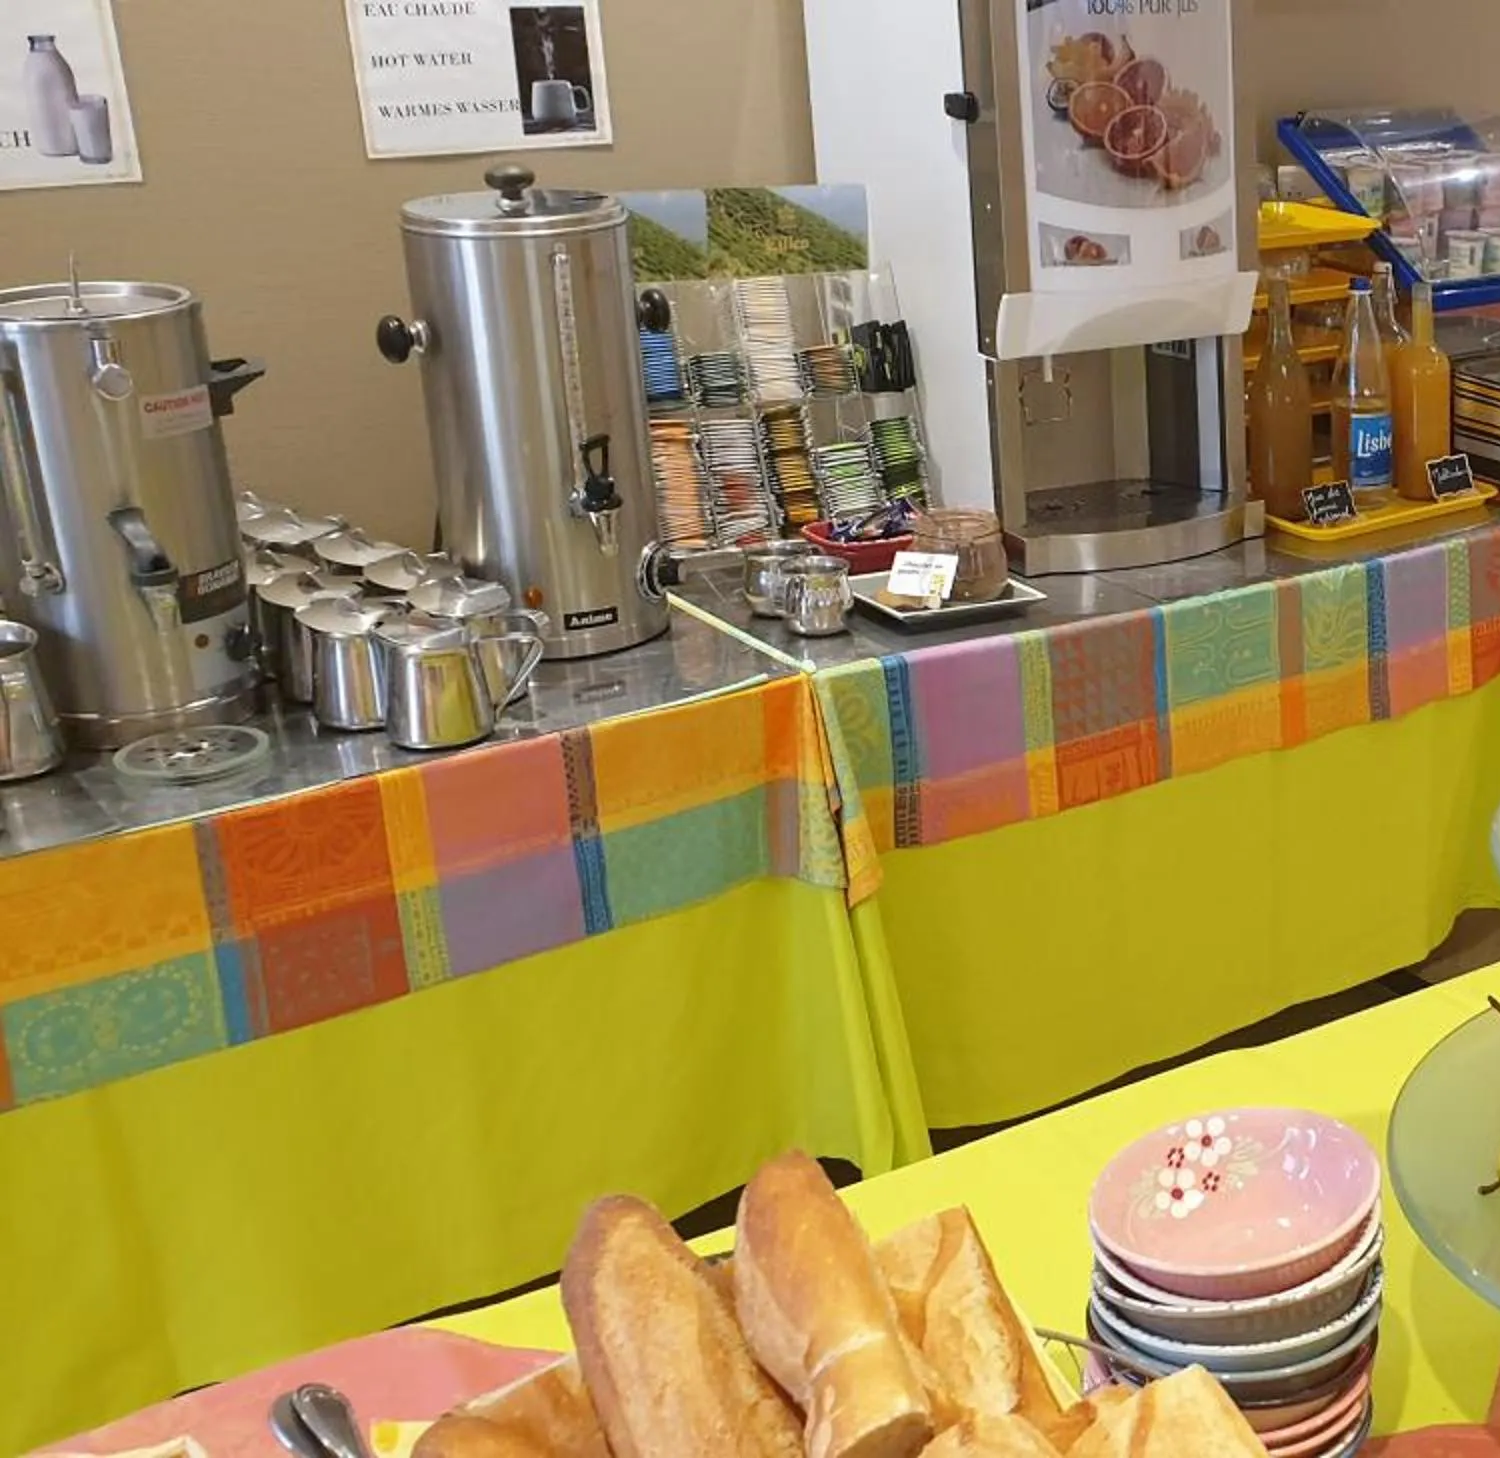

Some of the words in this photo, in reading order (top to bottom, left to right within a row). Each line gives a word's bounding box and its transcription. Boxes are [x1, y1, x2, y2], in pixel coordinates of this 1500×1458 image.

[364, 2, 400, 18] EAU
[404, 1, 476, 17] CHAUDE
[371, 54, 408, 69] HOT
[412, 52, 473, 68] WATER
[378, 102, 451, 120] WARMES
[455, 98, 521, 115] WASSER
